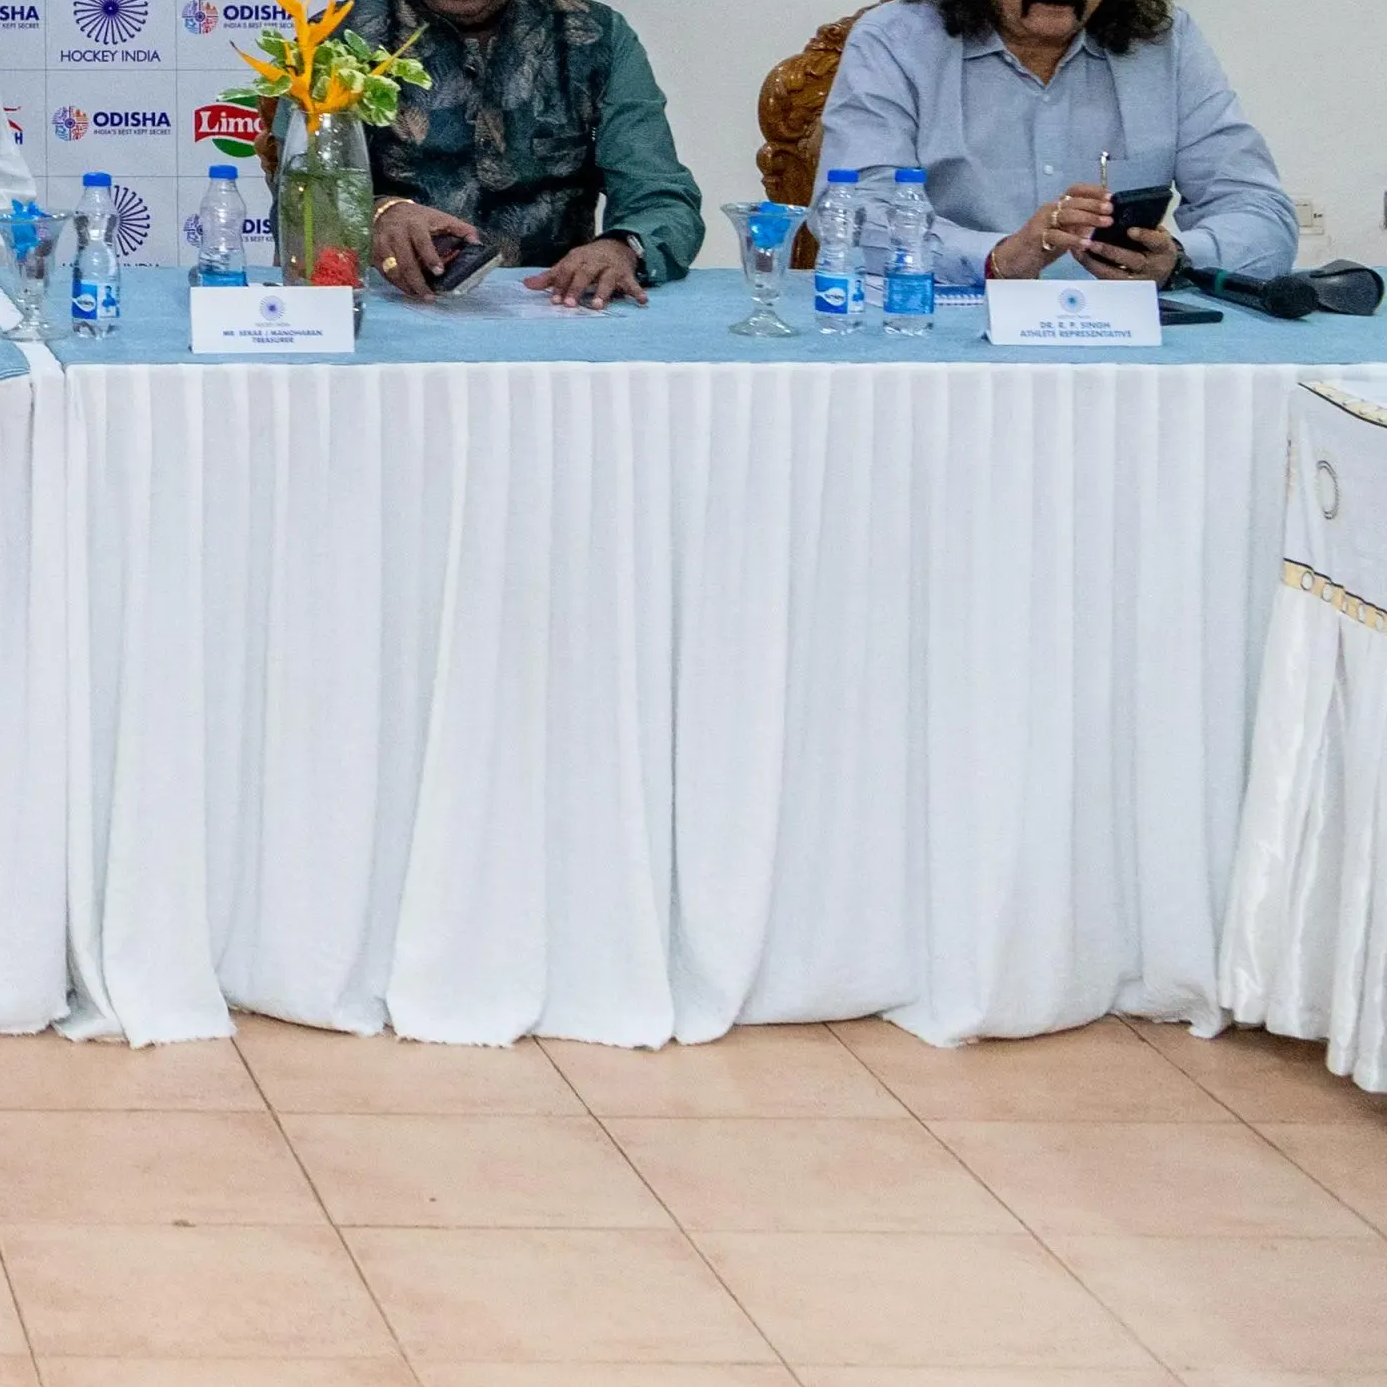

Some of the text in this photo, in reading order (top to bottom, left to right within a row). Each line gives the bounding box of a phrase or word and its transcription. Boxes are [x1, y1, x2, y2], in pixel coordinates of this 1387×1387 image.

[223, 3, 294, 20] ODISH
[61, 50, 160, 62] HOCKEY INDIA
[93, 112, 172, 127] ODISHA
